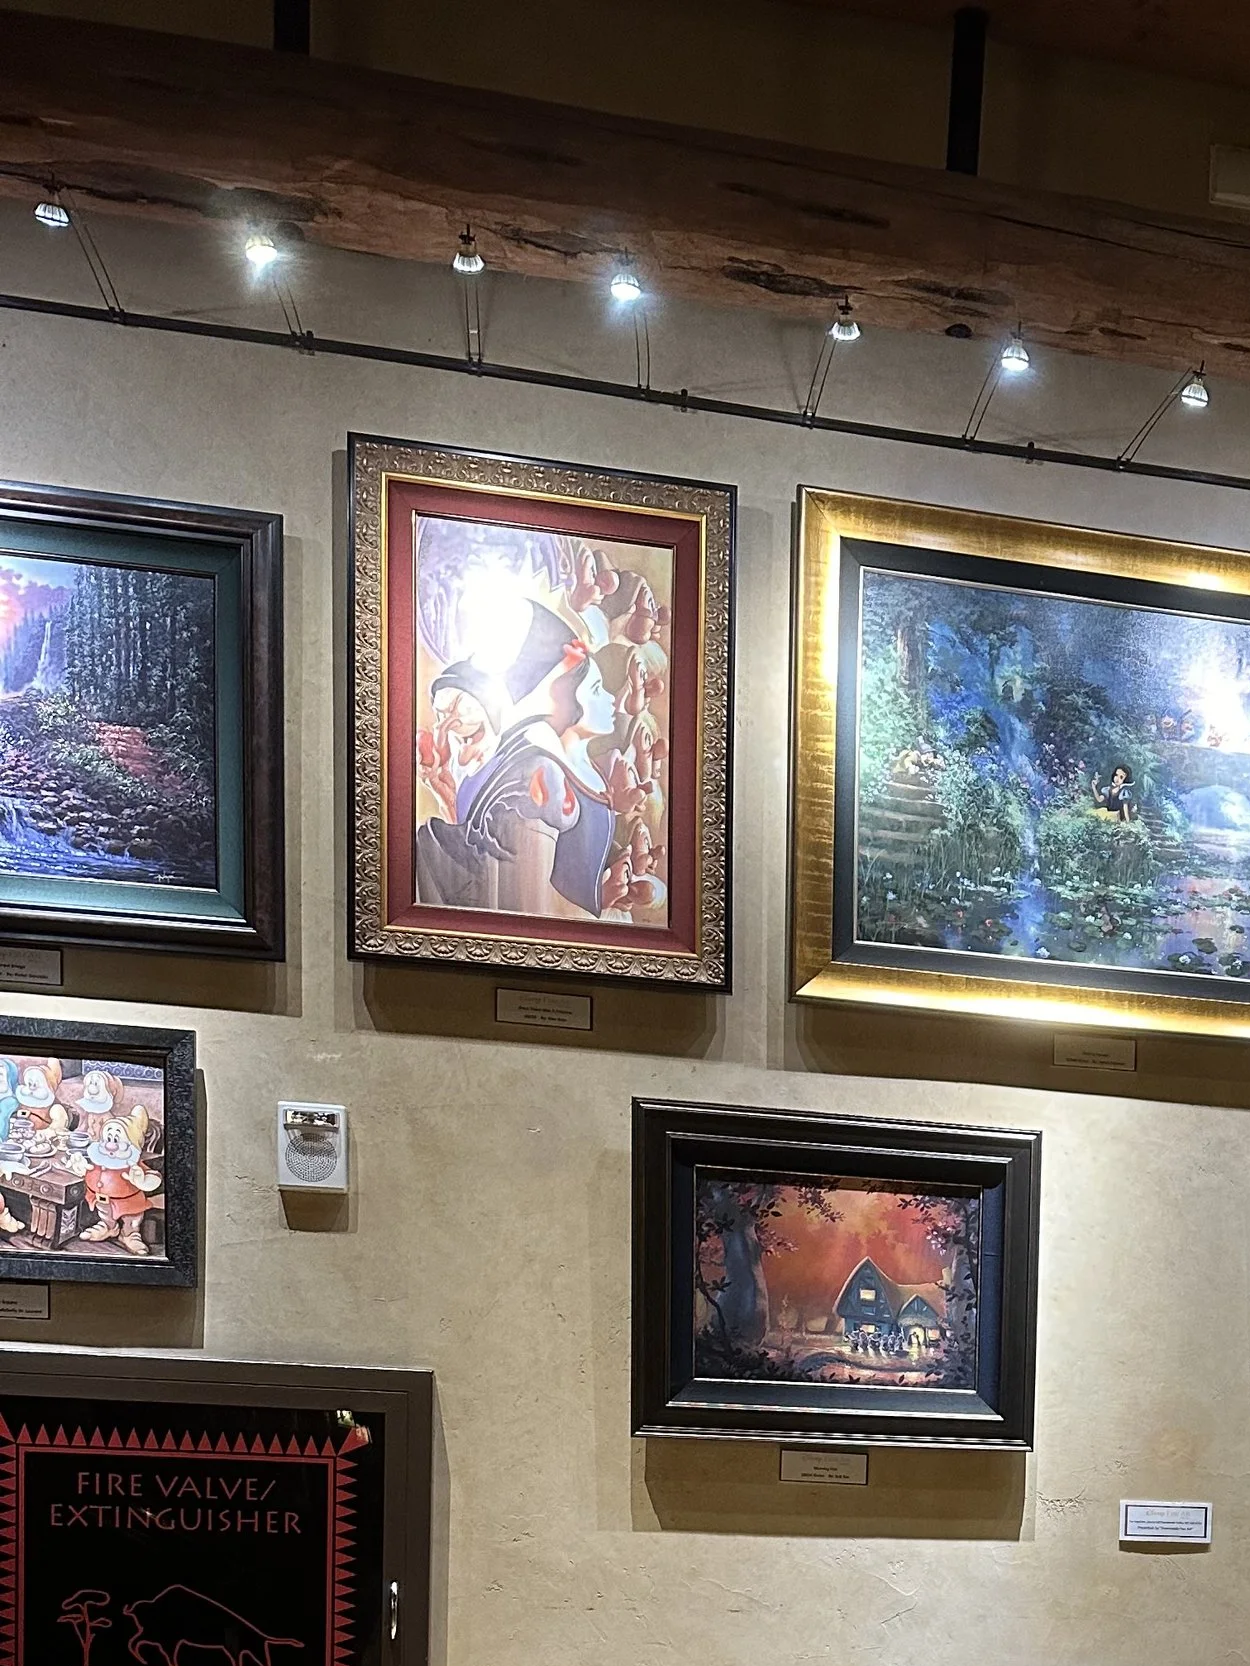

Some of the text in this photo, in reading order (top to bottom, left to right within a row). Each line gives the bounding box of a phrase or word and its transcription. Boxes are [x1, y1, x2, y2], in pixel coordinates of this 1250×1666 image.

[77, 1472, 276, 1501] FIRE VALVE/
[50, 1503, 302, 1534] EXTINGUISHER
